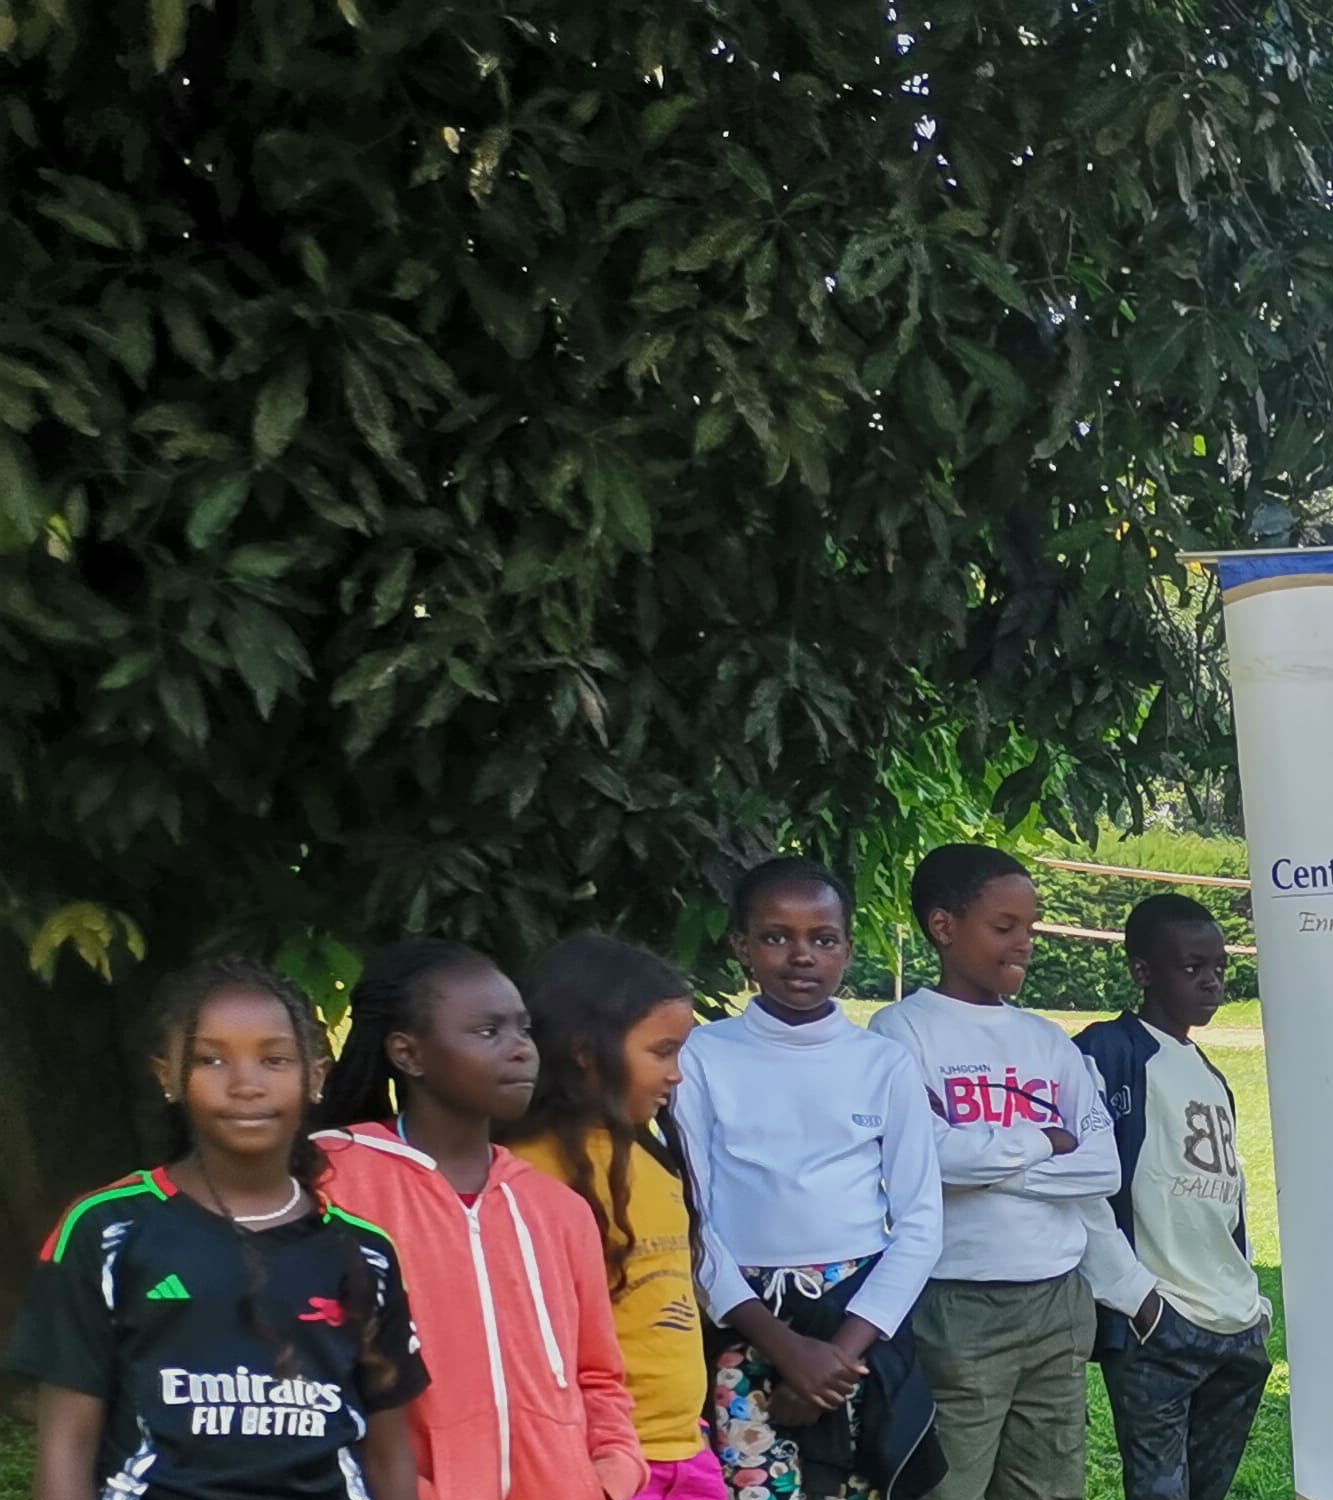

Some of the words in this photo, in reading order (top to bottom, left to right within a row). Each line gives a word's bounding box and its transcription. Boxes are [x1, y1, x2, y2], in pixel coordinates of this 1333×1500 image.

[159, 1365, 342, 1413] Emirates
[191, 1406, 235, 1435] FLY
[241, 1407, 326, 1437] BETTER
